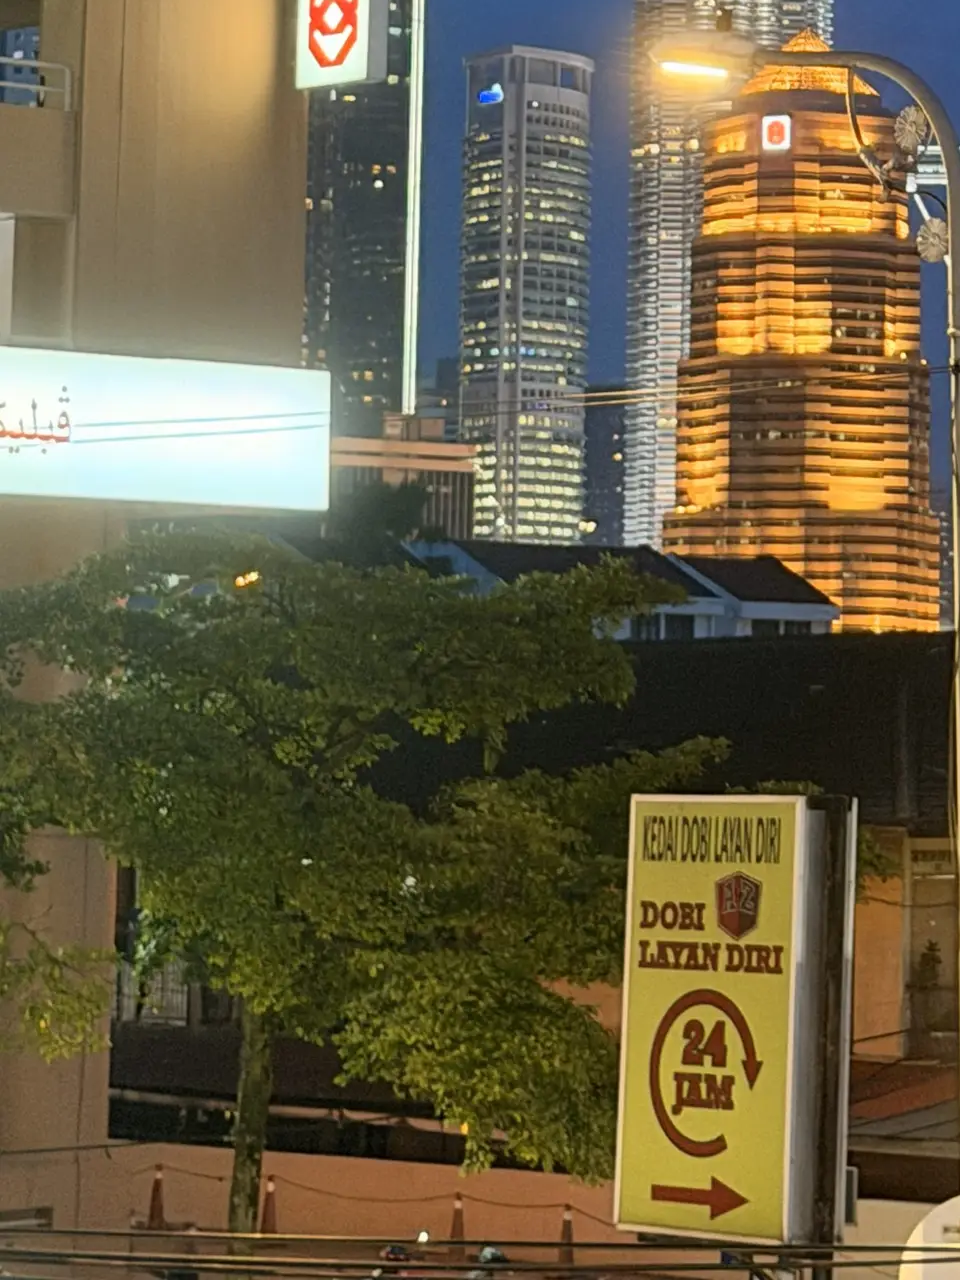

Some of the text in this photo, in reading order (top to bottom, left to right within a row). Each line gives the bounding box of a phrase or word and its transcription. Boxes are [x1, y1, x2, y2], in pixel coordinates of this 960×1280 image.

[643, 815, 782, 865] KEDAI DOBI LAYAN DIRI
[640, 900, 706, 931] DOBI
[638, 940, 784, 975] LAYAN DIRI
[682, 1019, 728, 1068] 24
[671, 1072, 735, 1116] JAM
